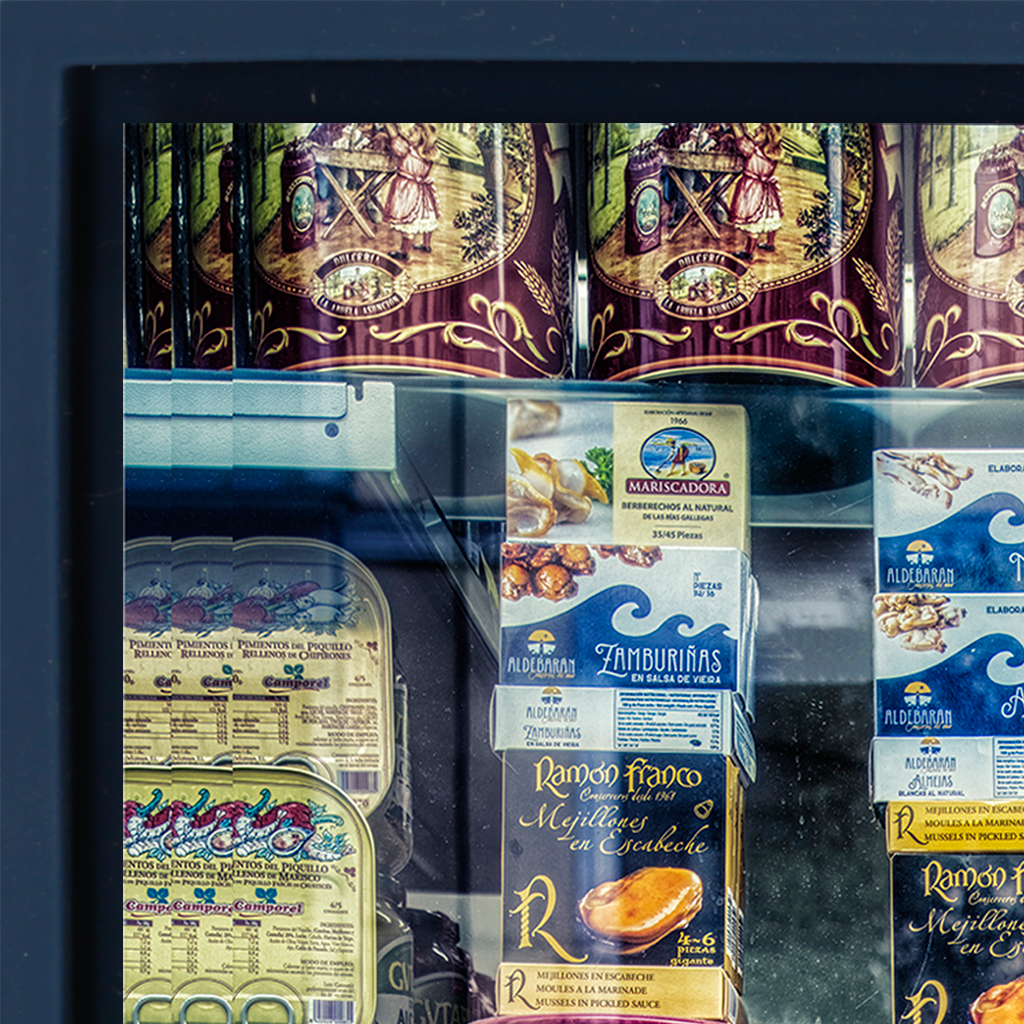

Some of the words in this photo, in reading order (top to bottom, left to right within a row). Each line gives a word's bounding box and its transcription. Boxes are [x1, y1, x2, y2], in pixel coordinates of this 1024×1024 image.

[627, 480, 729, 495] MARISCADORA
[621, 502, 681, 512] BERBERECHOS
[682, 503, 694, 511] AL
[695, 503, 734, 513] NATURAL
[676, 531, 703, 541] Piezas
[594, 642, 722, 678] ZAMBURIÑAS
[631, 674, 645, 683] EN
[646, 674, 676, 684] SALSA
[678, 675, 691, 684] DE
[693, 675, 722, 685] VIEIRA
[518, 802, 649, 842] Mejillones
[570, 837, 595, 851] en
[599, 824, 710, 857] Escabeche
[281, 862, 329, 874] PIQUILLO
[278, 873, 321, 883] MARISCO
[233, 900, 304, 915] Camporel
[960, 942, 984, 955] en
